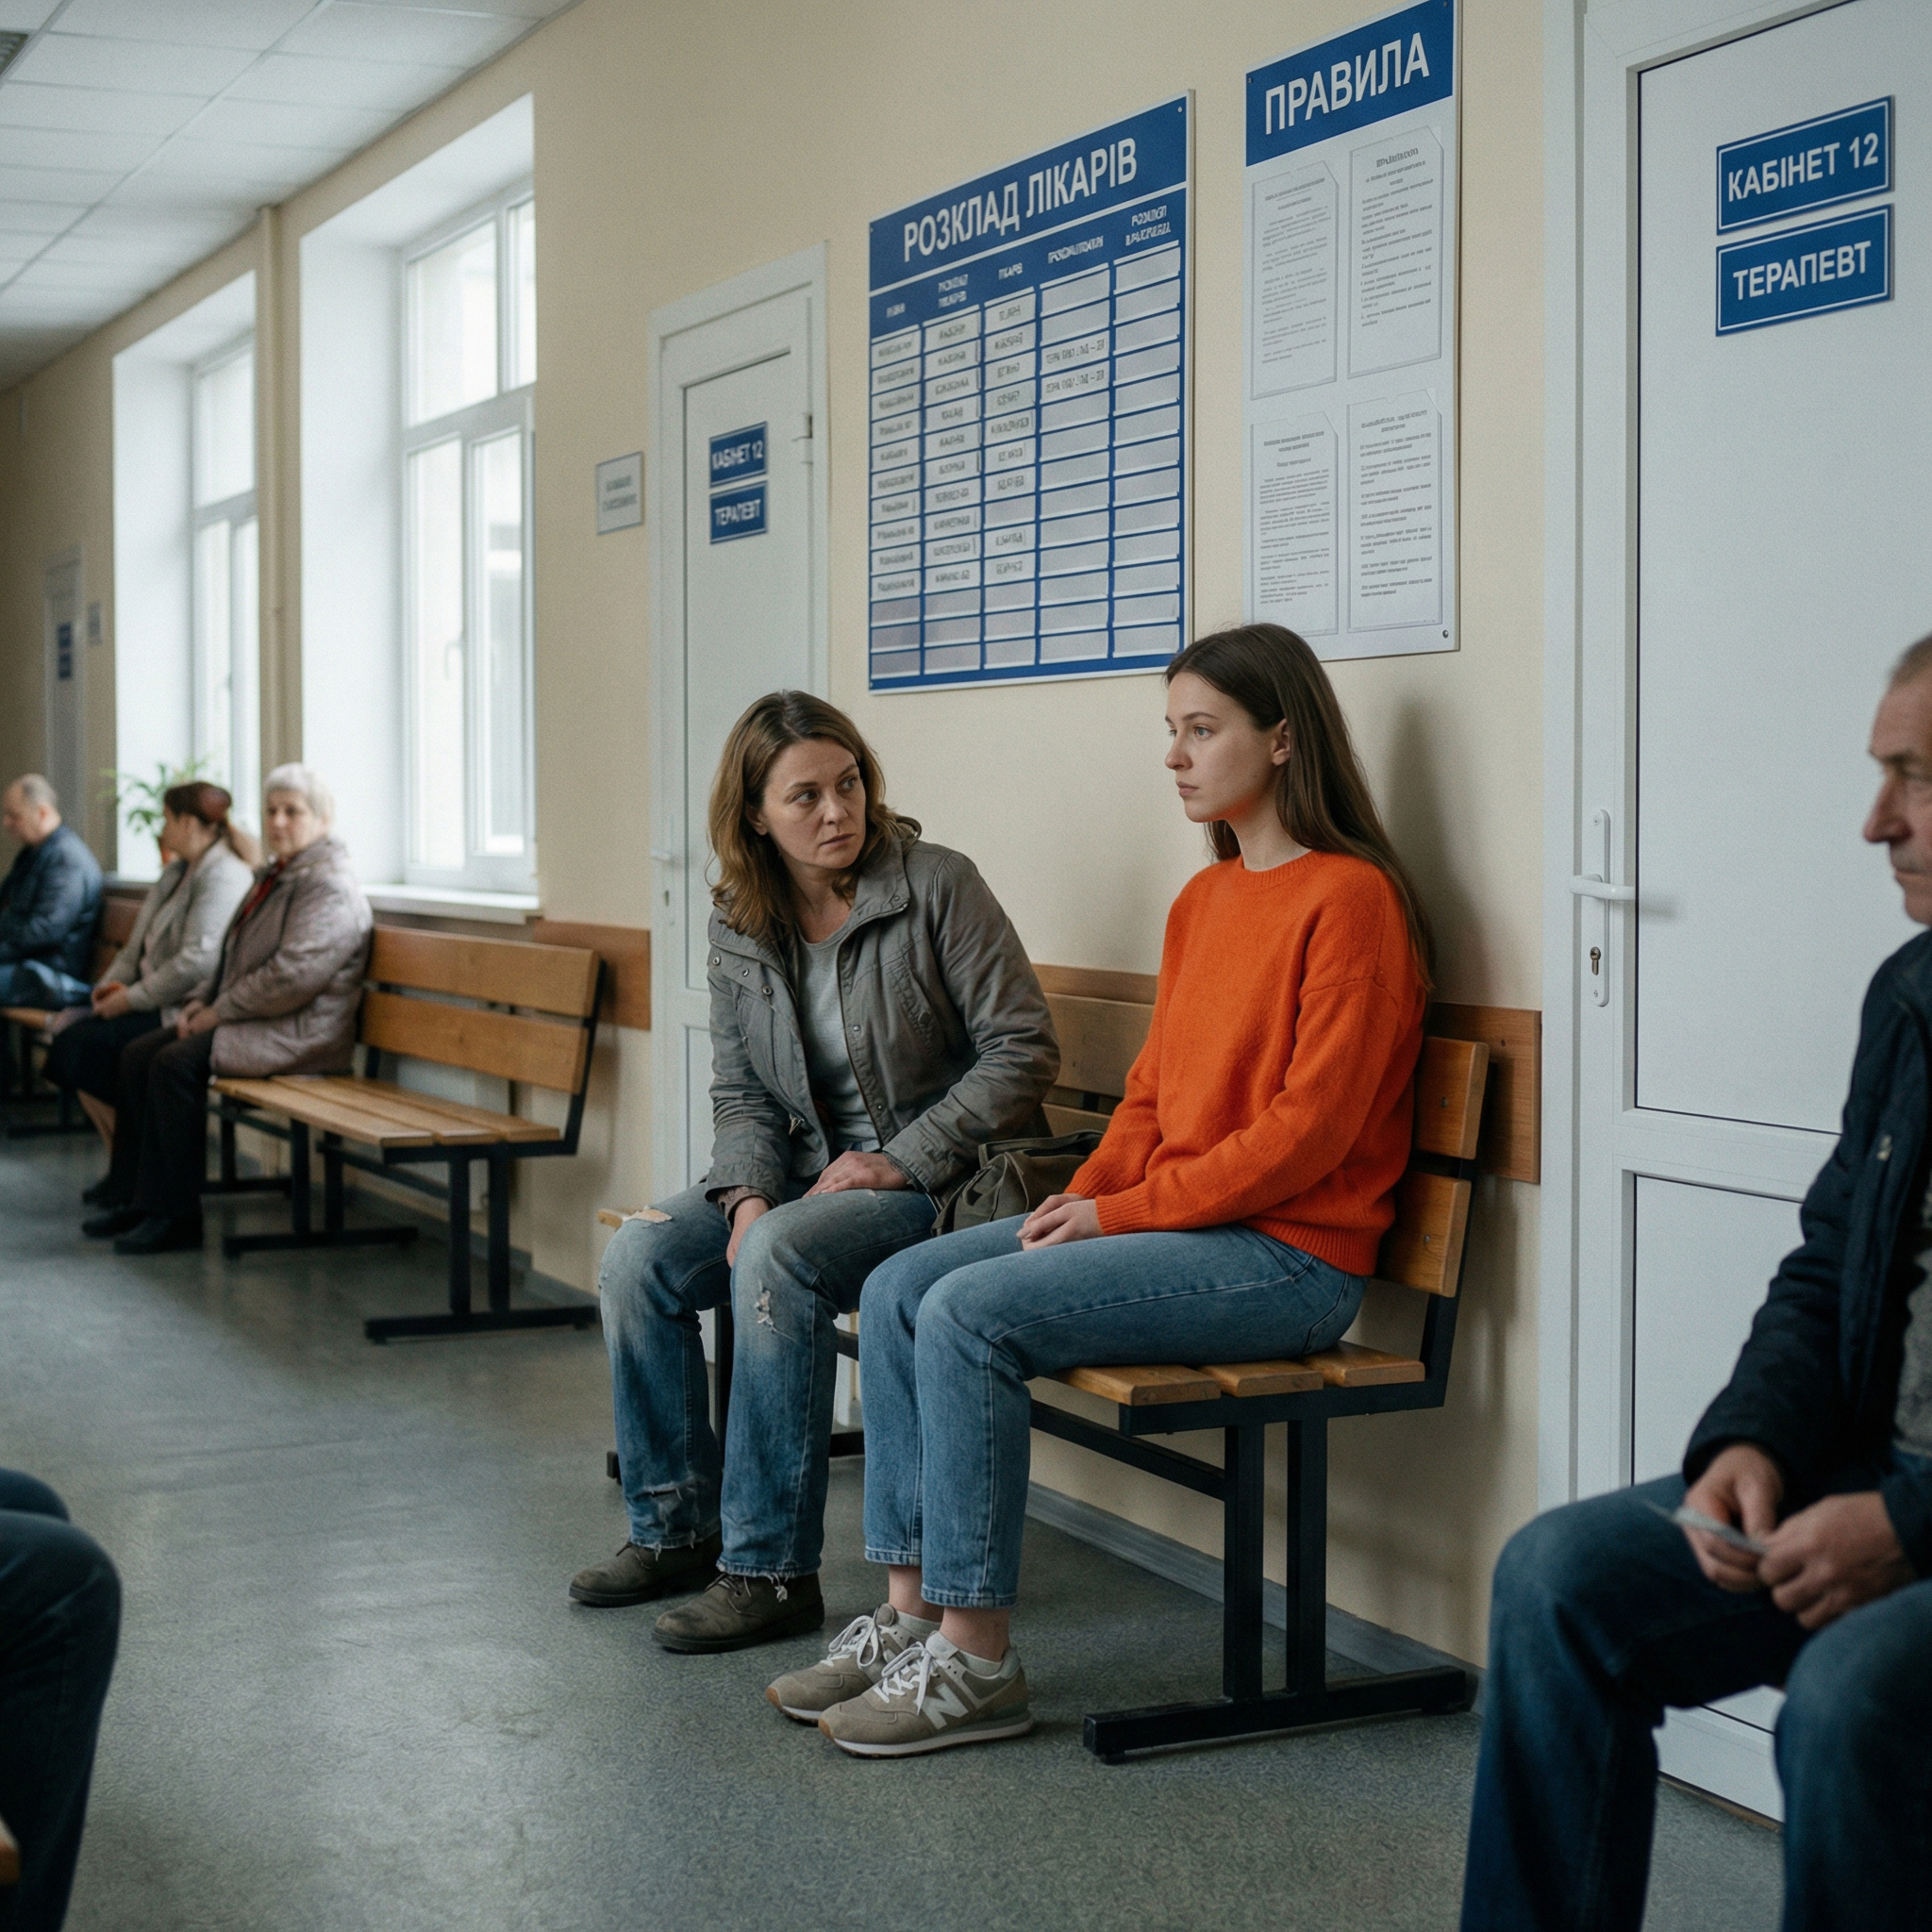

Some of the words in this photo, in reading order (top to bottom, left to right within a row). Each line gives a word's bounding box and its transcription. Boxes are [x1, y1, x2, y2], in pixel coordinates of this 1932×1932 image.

[1265, 32, 1430, 135] ПРАВИЛА
[904, 181, 1021, 263] РОЗКЛАД
[1025, 137, 1138, 218] ЛІКАРІВ
[1727, 142, 1840, 203] КАБІНЕТ
[1848, 132, 1879, 169] 12
[1732, 240, 1872, 300] ТЕРАПЕВТ
